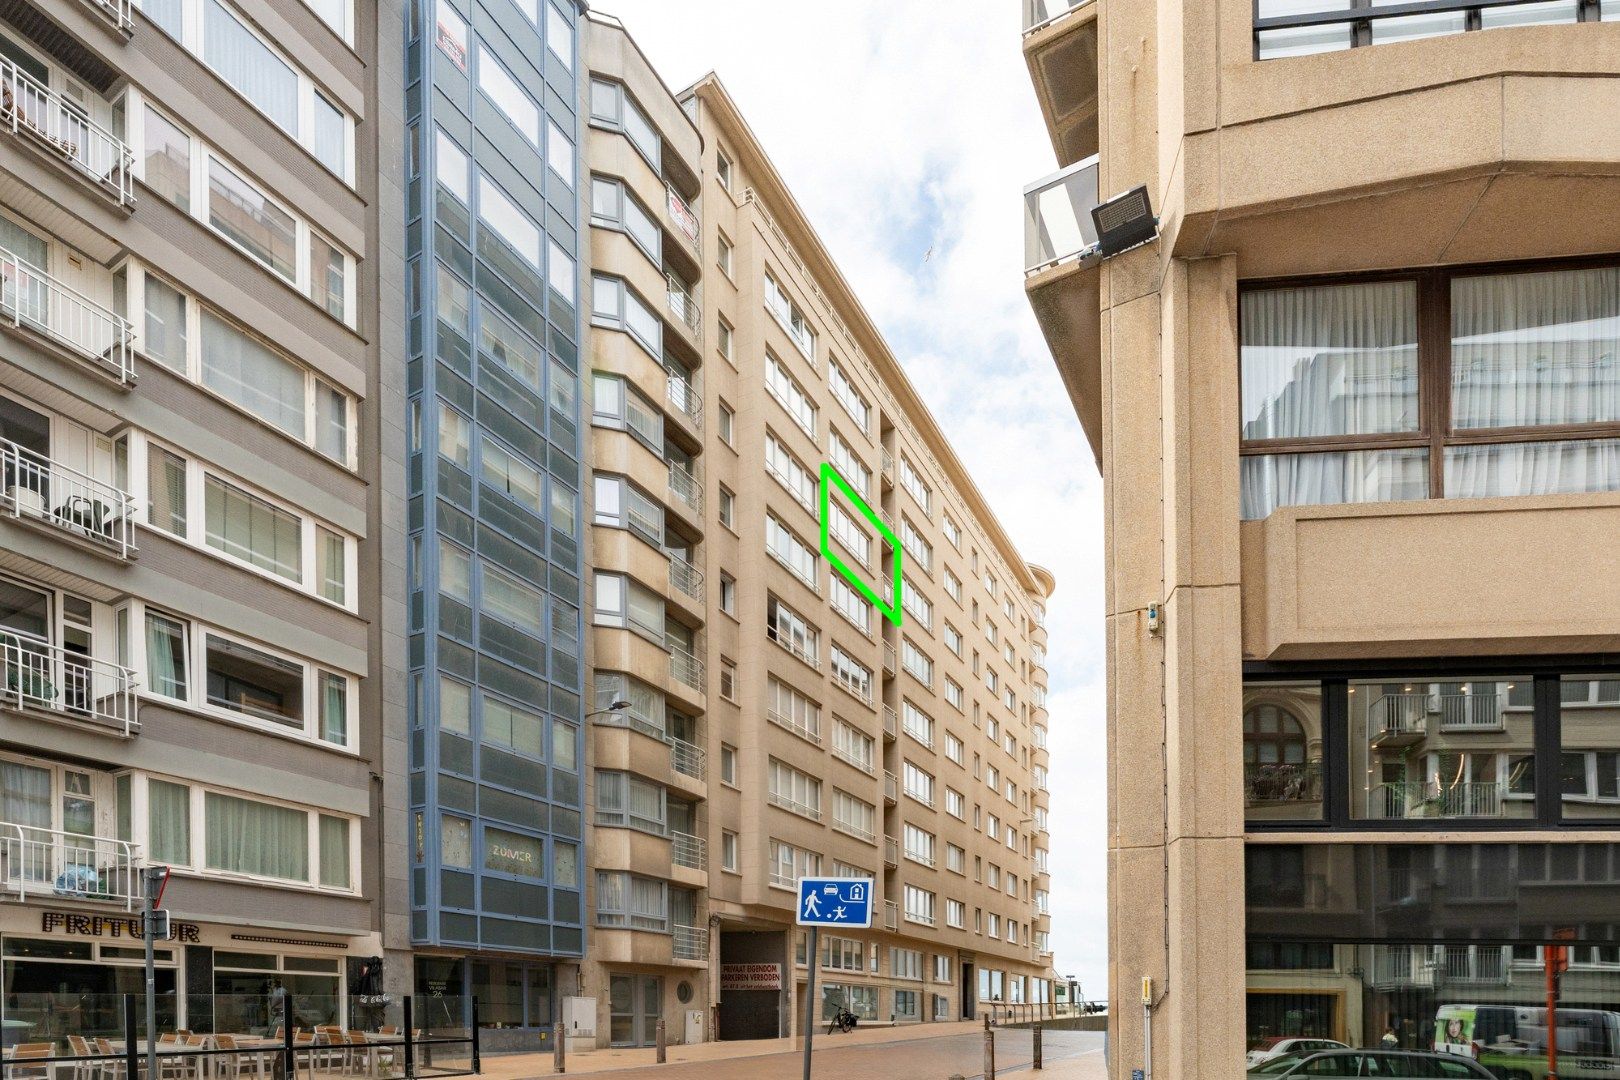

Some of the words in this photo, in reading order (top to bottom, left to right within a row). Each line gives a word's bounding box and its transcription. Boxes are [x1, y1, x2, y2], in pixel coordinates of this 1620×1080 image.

[723, 965, 746, 973] PRIVAAT
[747, 965, 777, 973] EIGENDOM
[721, 973, 748, 981] PARKEREN
[750, 973, 780, 981] VERBODEN
